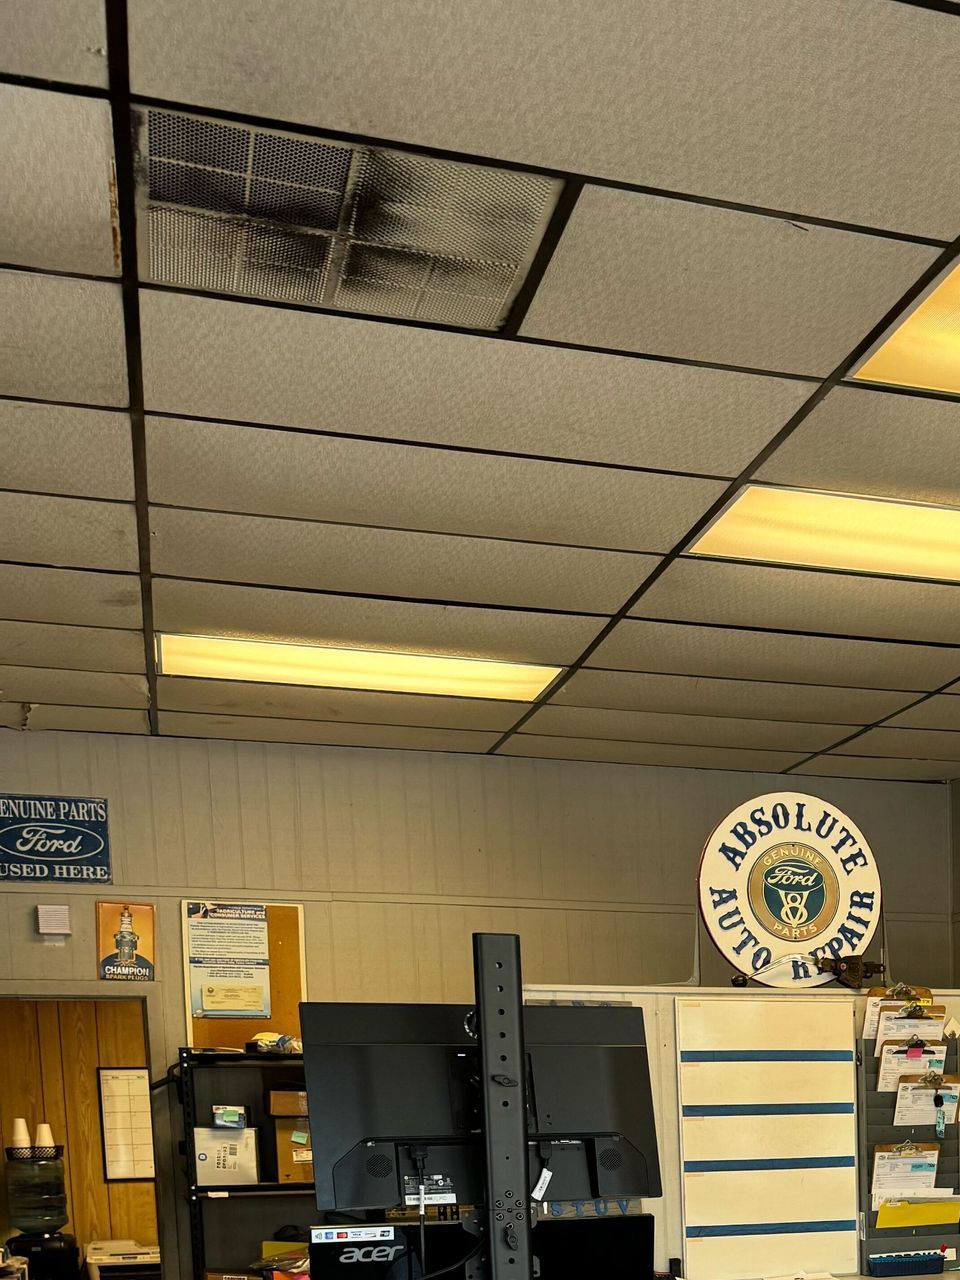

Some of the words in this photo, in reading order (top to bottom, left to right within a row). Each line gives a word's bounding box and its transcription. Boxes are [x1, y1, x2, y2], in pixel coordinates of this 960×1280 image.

[0, 799, 55, 819] ENUINE
[60, 802, 106, 821] PARTS
[16, 827, 83, 853] Ford
[719, 802, 868, 875] ABSOLUTE
[764, 846, 823, 866] GENUINE
[0, 863, 48, 877] USED
[767, 866, 818, 886] Ford
[709, 887, 772, 971] AUTO
[773, 924, 818, 937] PARTS
[105, 966, 149, 976] CHAMPION
[339, 1246, 404, 1263] acer
